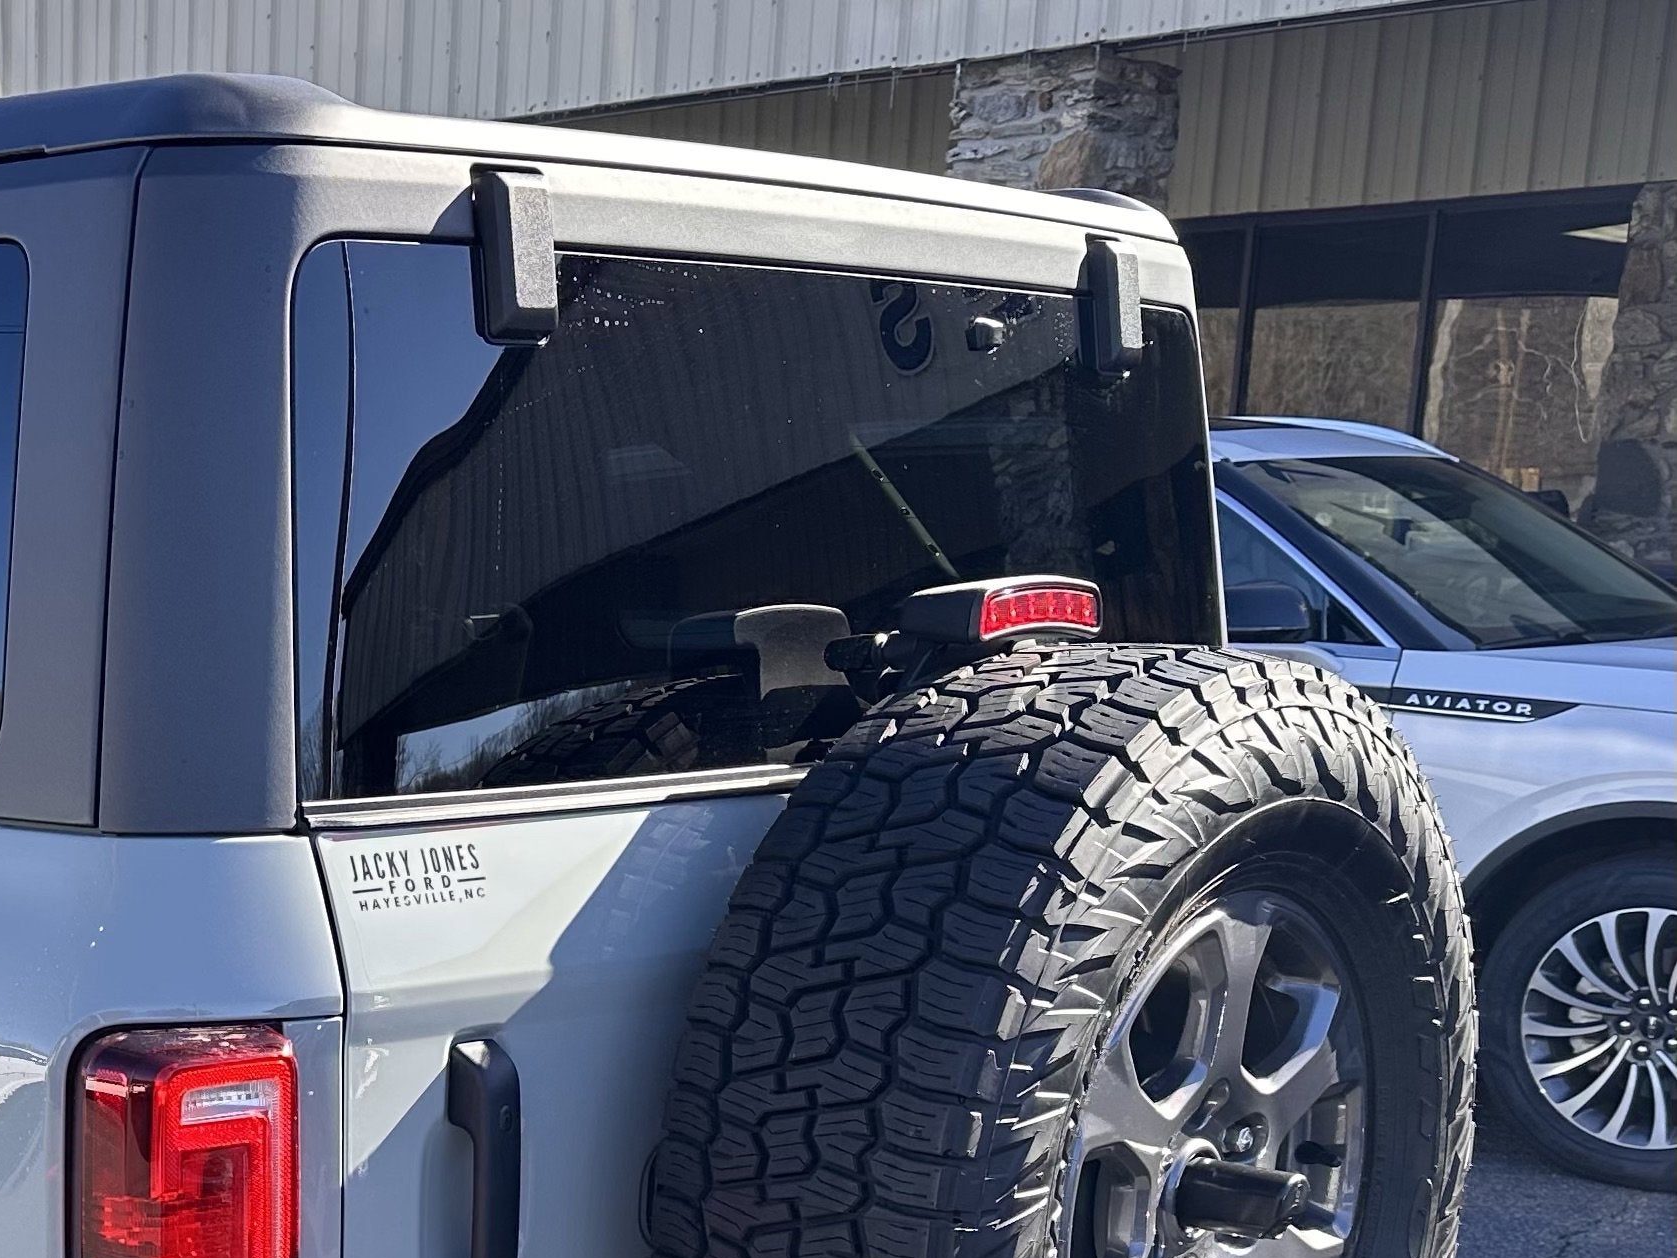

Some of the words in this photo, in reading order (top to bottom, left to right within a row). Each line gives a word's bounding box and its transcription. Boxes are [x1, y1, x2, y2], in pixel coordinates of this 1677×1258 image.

[1405, 693, 1533, 716] AVIATOR
[349, 849, 411, 882] JACKY
[420, 843, 481, 874] JONES
[388, 874, 452, 894] FORD
